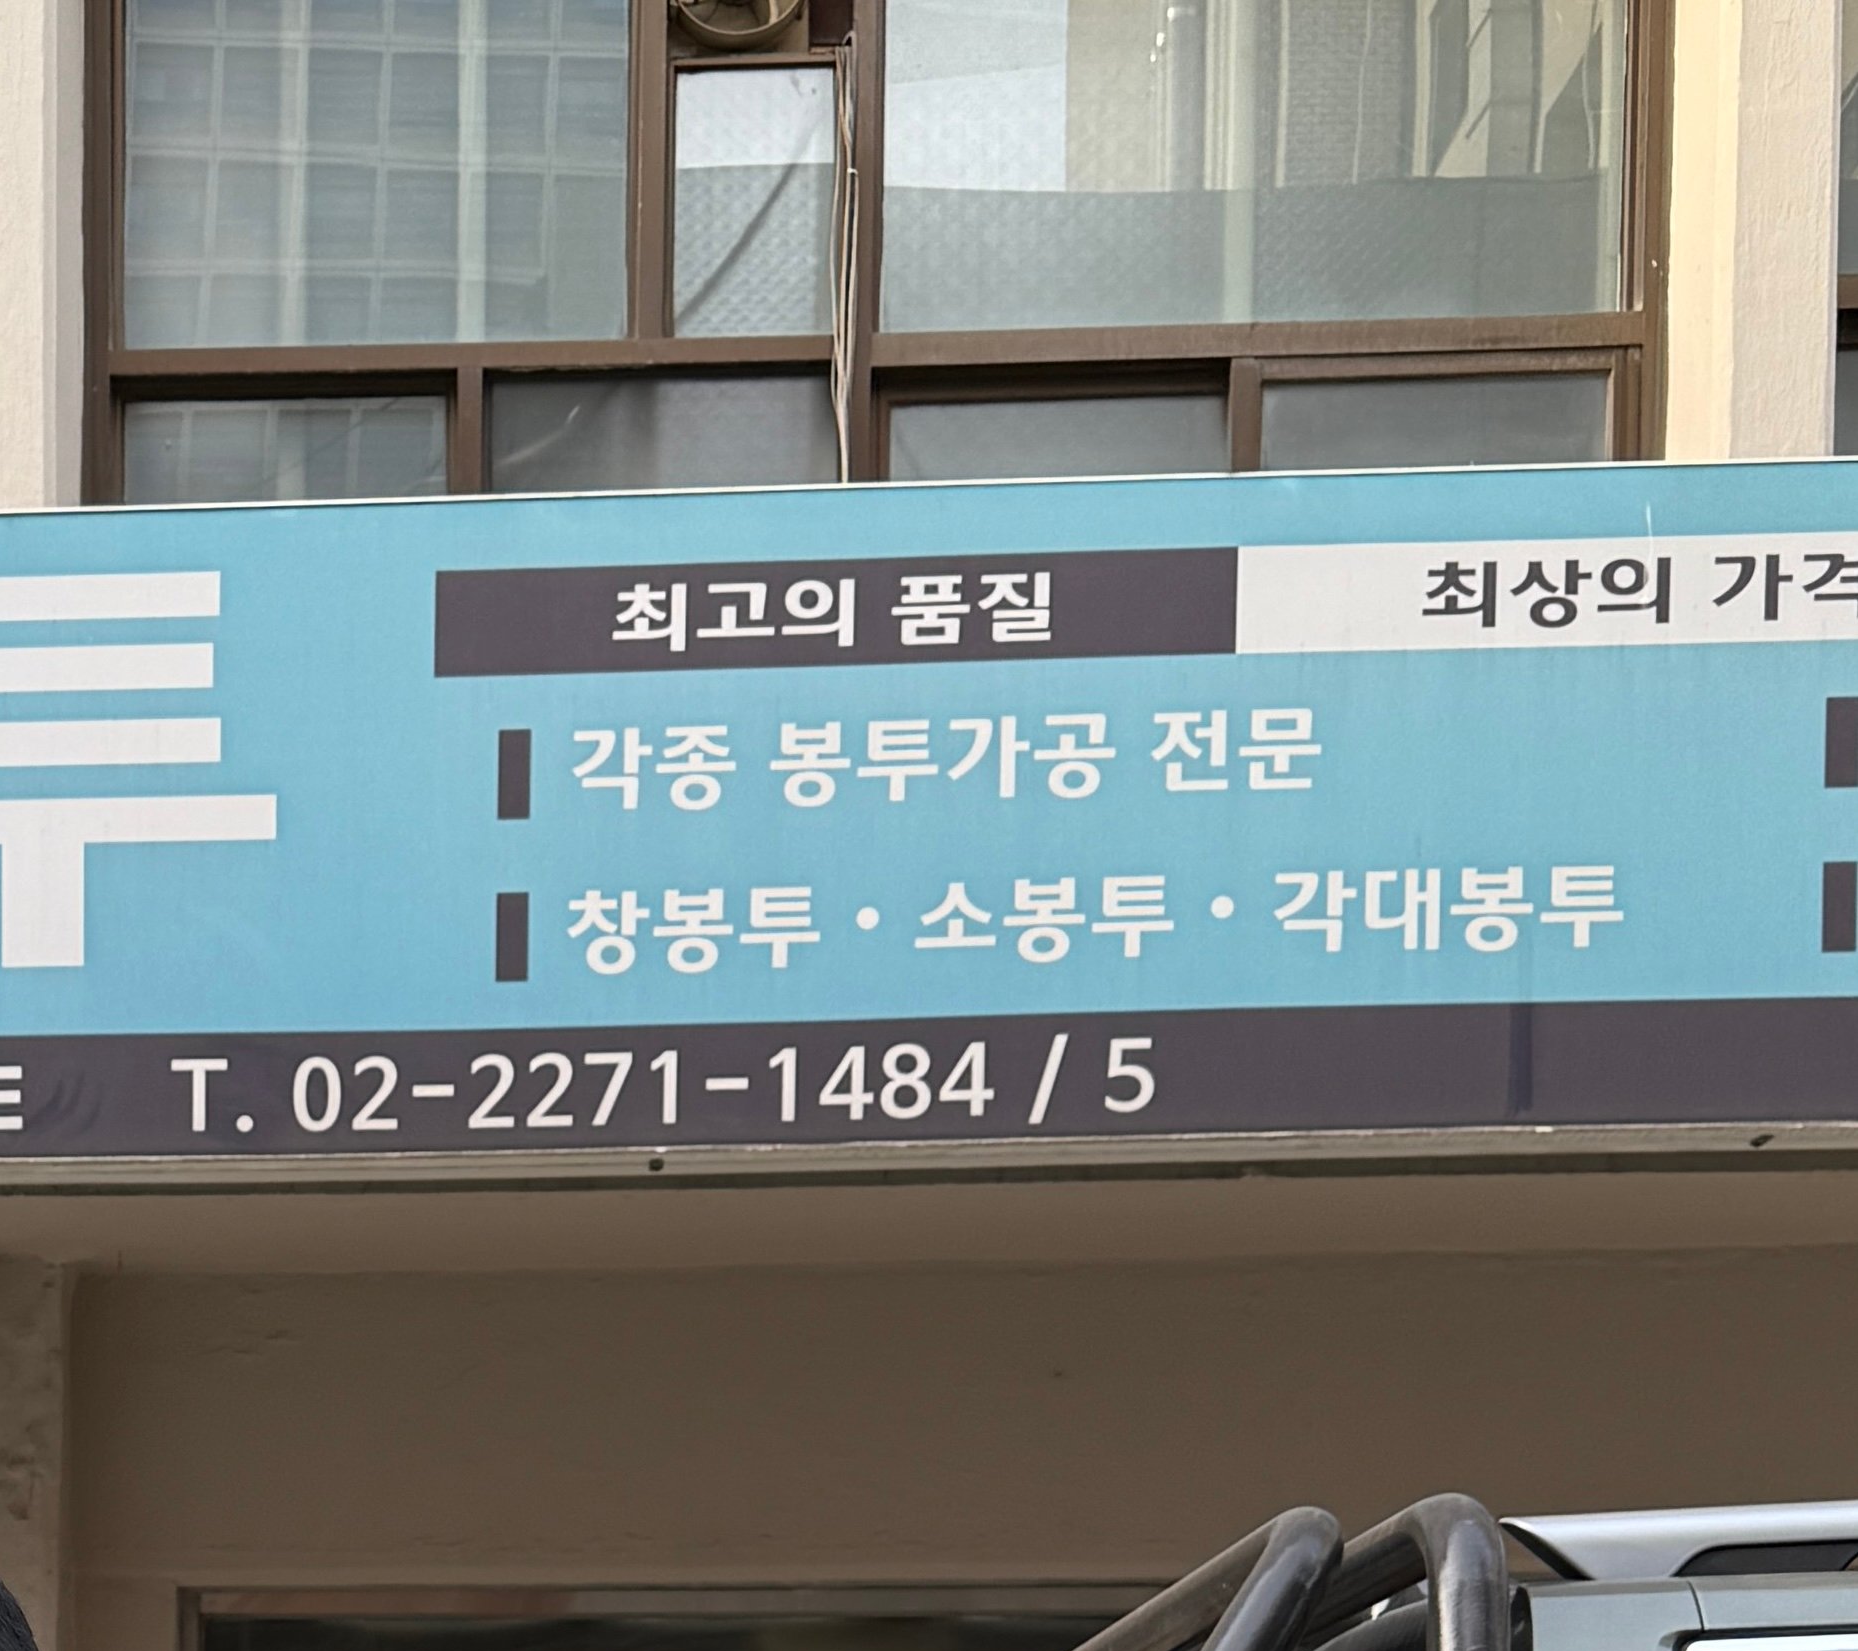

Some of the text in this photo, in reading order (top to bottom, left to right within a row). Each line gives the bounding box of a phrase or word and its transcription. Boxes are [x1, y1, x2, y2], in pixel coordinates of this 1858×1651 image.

[613, 572, 1050, 651] 최고의 품질
[1423, 558, 1671, 627] 최상의
[571, 707, 1322, 810] 각종 봉투가공 전문
[566, 865, 1625, 974] 창봉투 소봉투 각대봉투
[171, 1058, 253, 1132] T.
[293, 1042, 994, 1131] 02-2271-1484
[1105, 1038, 1154, 1112] 5
